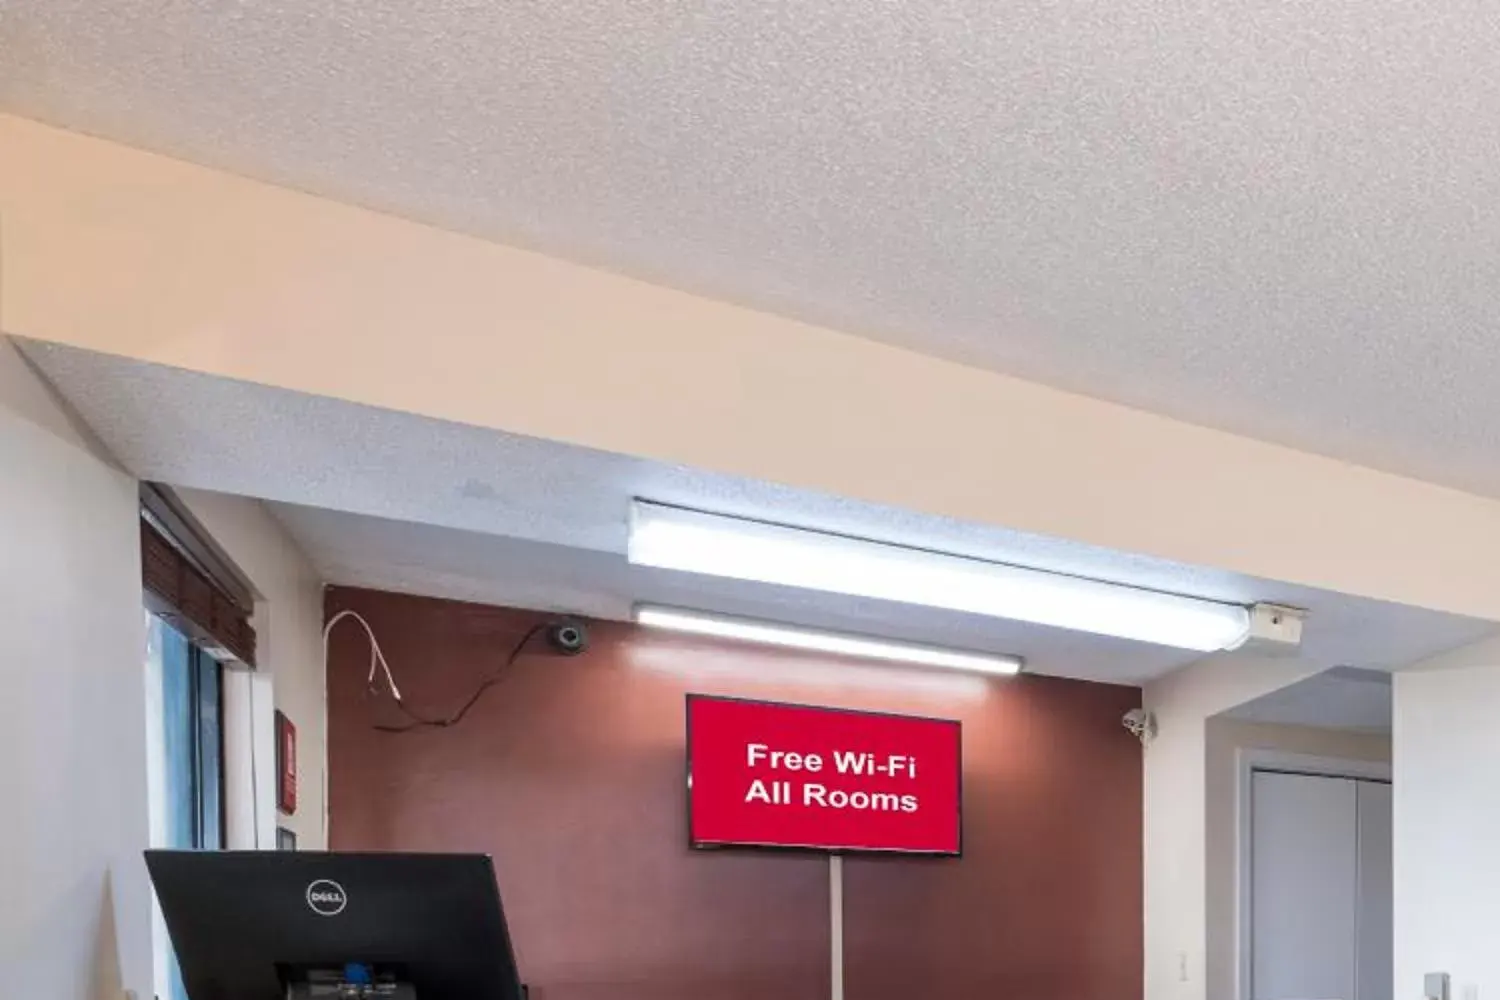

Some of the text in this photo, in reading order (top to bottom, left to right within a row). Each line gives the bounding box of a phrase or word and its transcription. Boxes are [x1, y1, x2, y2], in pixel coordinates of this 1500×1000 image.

[747, 743, 916, 779] Free Wi-Fi
[745, 779, 918, 813] All Rooms
[311, 891, 342, 902] DELL
